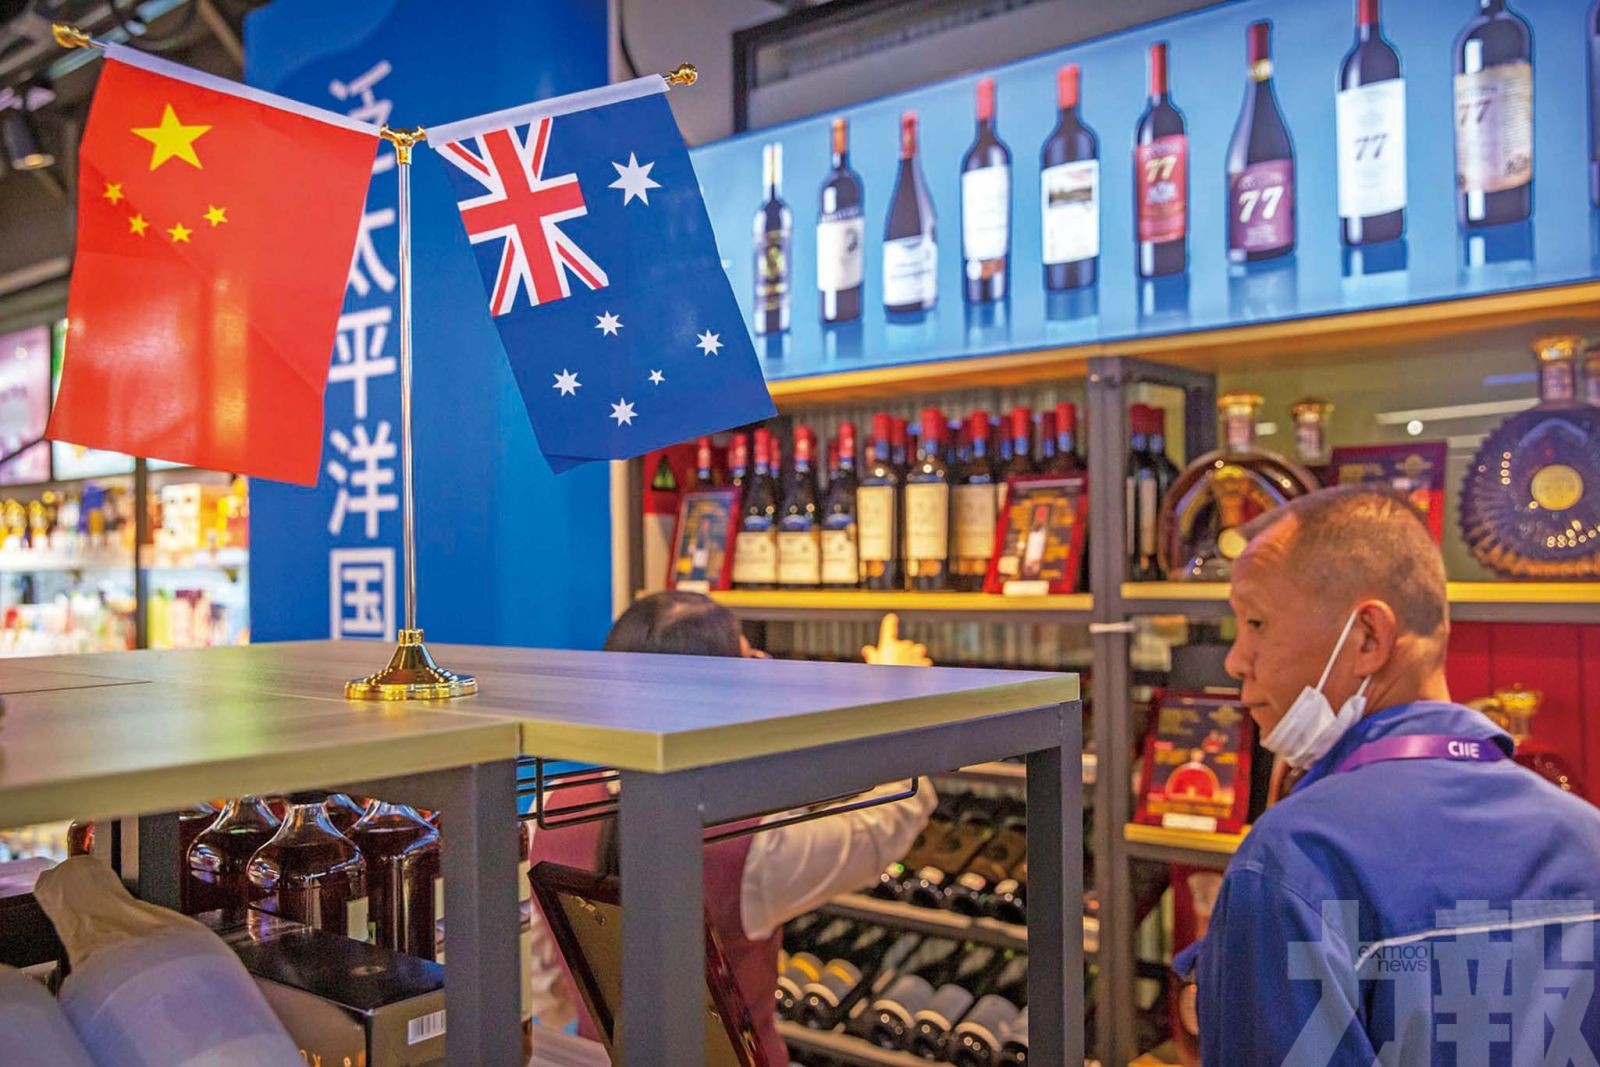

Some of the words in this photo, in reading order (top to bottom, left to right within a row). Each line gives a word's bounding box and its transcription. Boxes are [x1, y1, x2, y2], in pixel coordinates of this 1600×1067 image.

[1354, 132, 1388, 162] 77
[1144, 154, 1178, 184] 77
[1237, 185, 1285, 224] 77
[1447, 740, 1480, 759] CIIE
